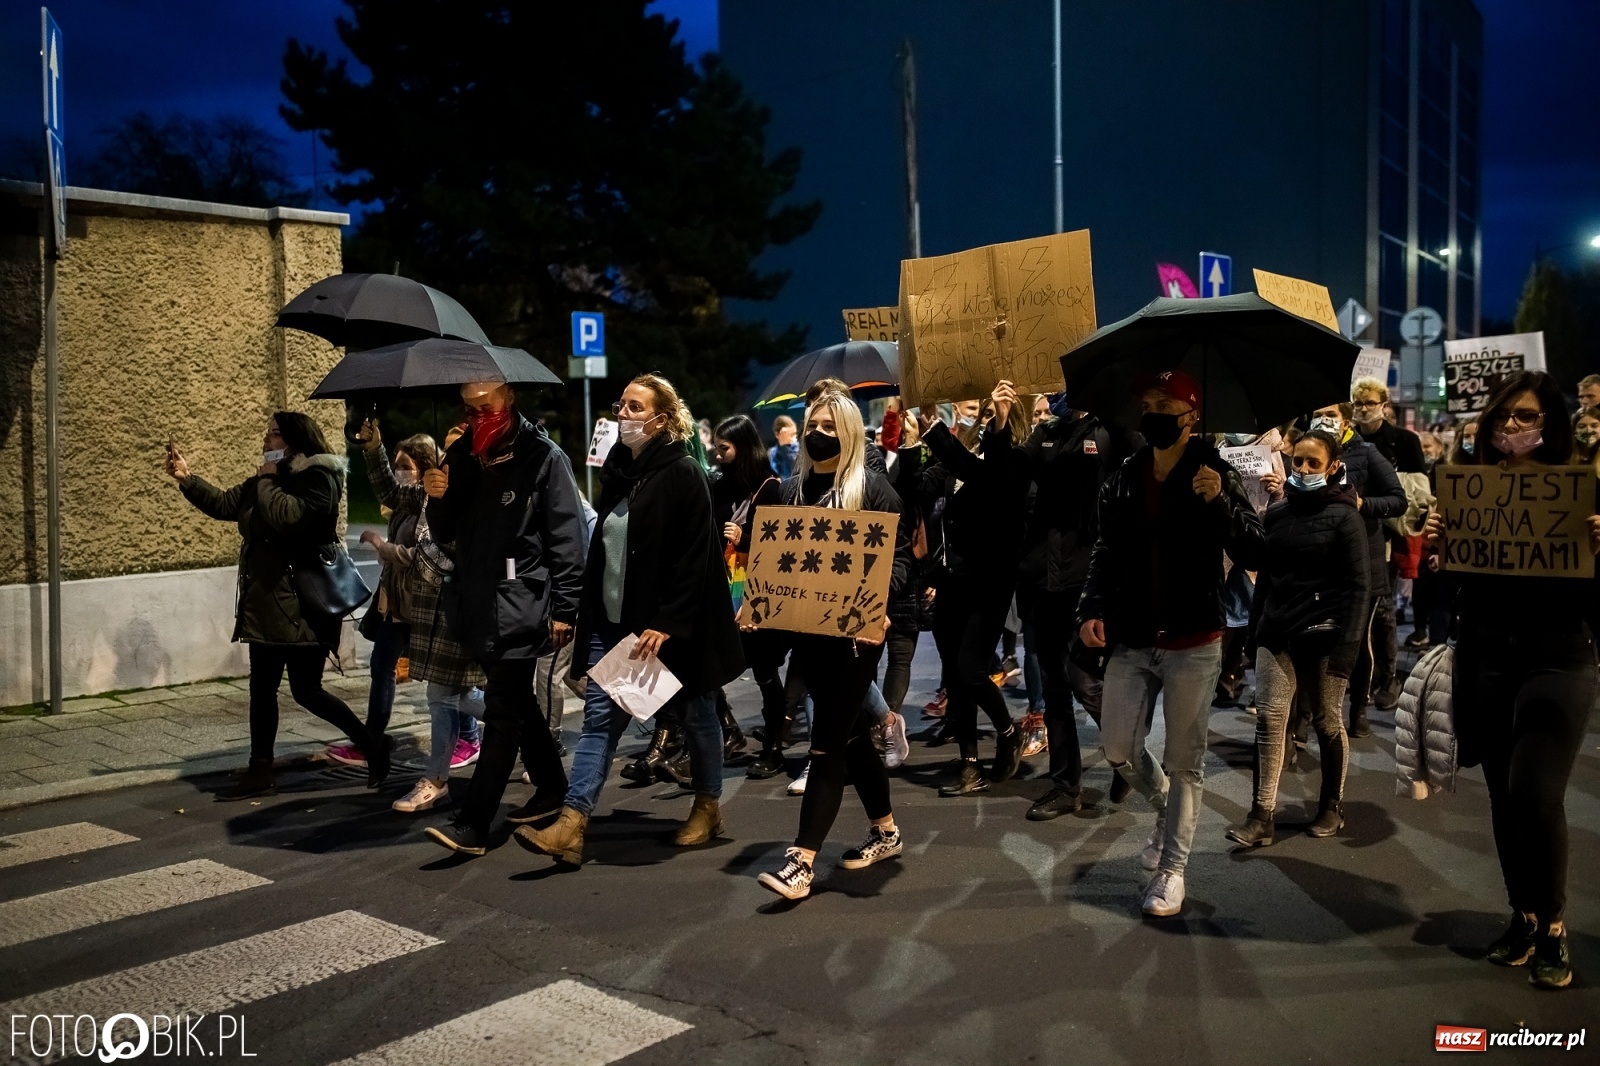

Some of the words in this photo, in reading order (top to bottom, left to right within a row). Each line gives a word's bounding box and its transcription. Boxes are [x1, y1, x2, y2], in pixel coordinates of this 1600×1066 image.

[580, 317, 598, 351] P
[848, 311, 888, 330] REAL
[1447, 358, 1521, 386] JESZCZE
[1457, 377, 1490, 394] POL
[1446, 473, 1483, 500] TO
[1495, 472, 1588, 507] JEST
[1445, 507, 1535, 537] WOJNA
[1544, 510, 1570, 538] Z
[1444, 537, 1579, 570] KOBIETAMI
